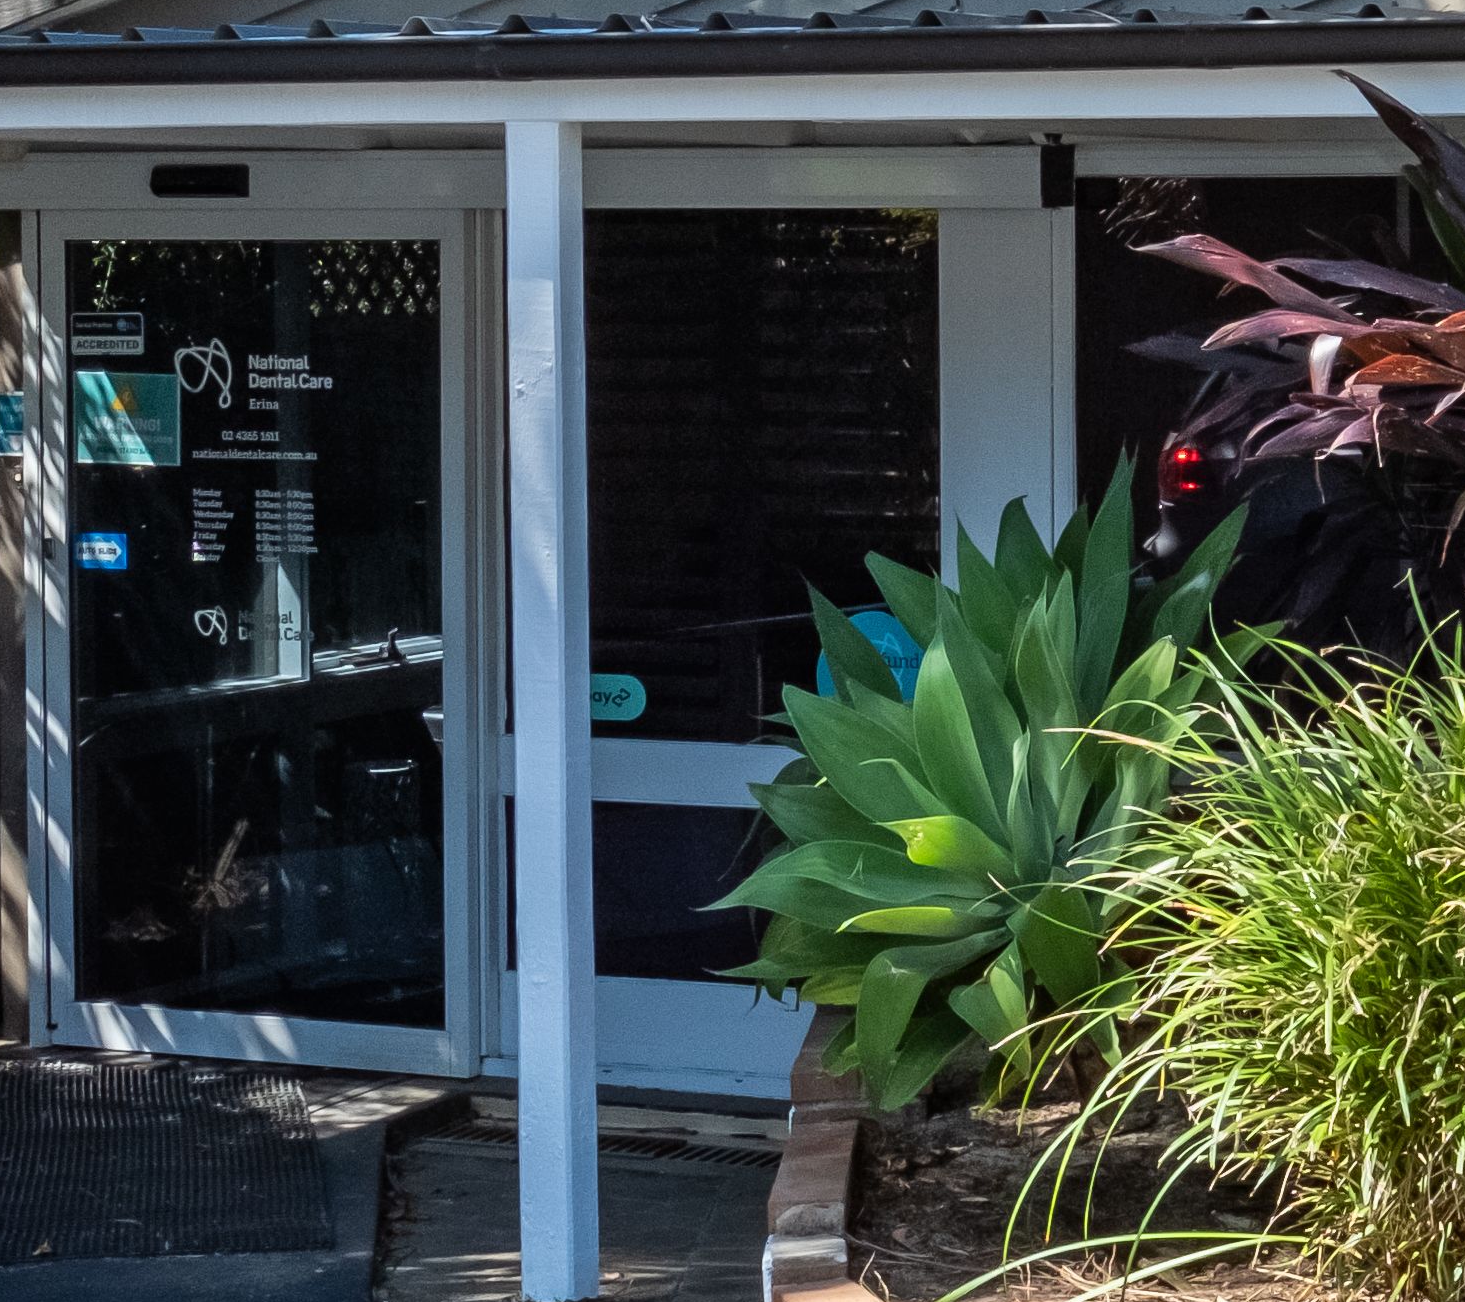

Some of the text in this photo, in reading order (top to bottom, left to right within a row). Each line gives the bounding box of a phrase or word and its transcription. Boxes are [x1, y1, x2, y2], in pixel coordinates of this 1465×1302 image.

[76, 340, 140, 350] ACCREDITED
[248, 354, 310, 371] National
[248, 398, 280, 411] Erina
[221, 430, 234, 441] 02
[238, 609, 294, 624] Naoal
[592, 691, 613, 707] ay
